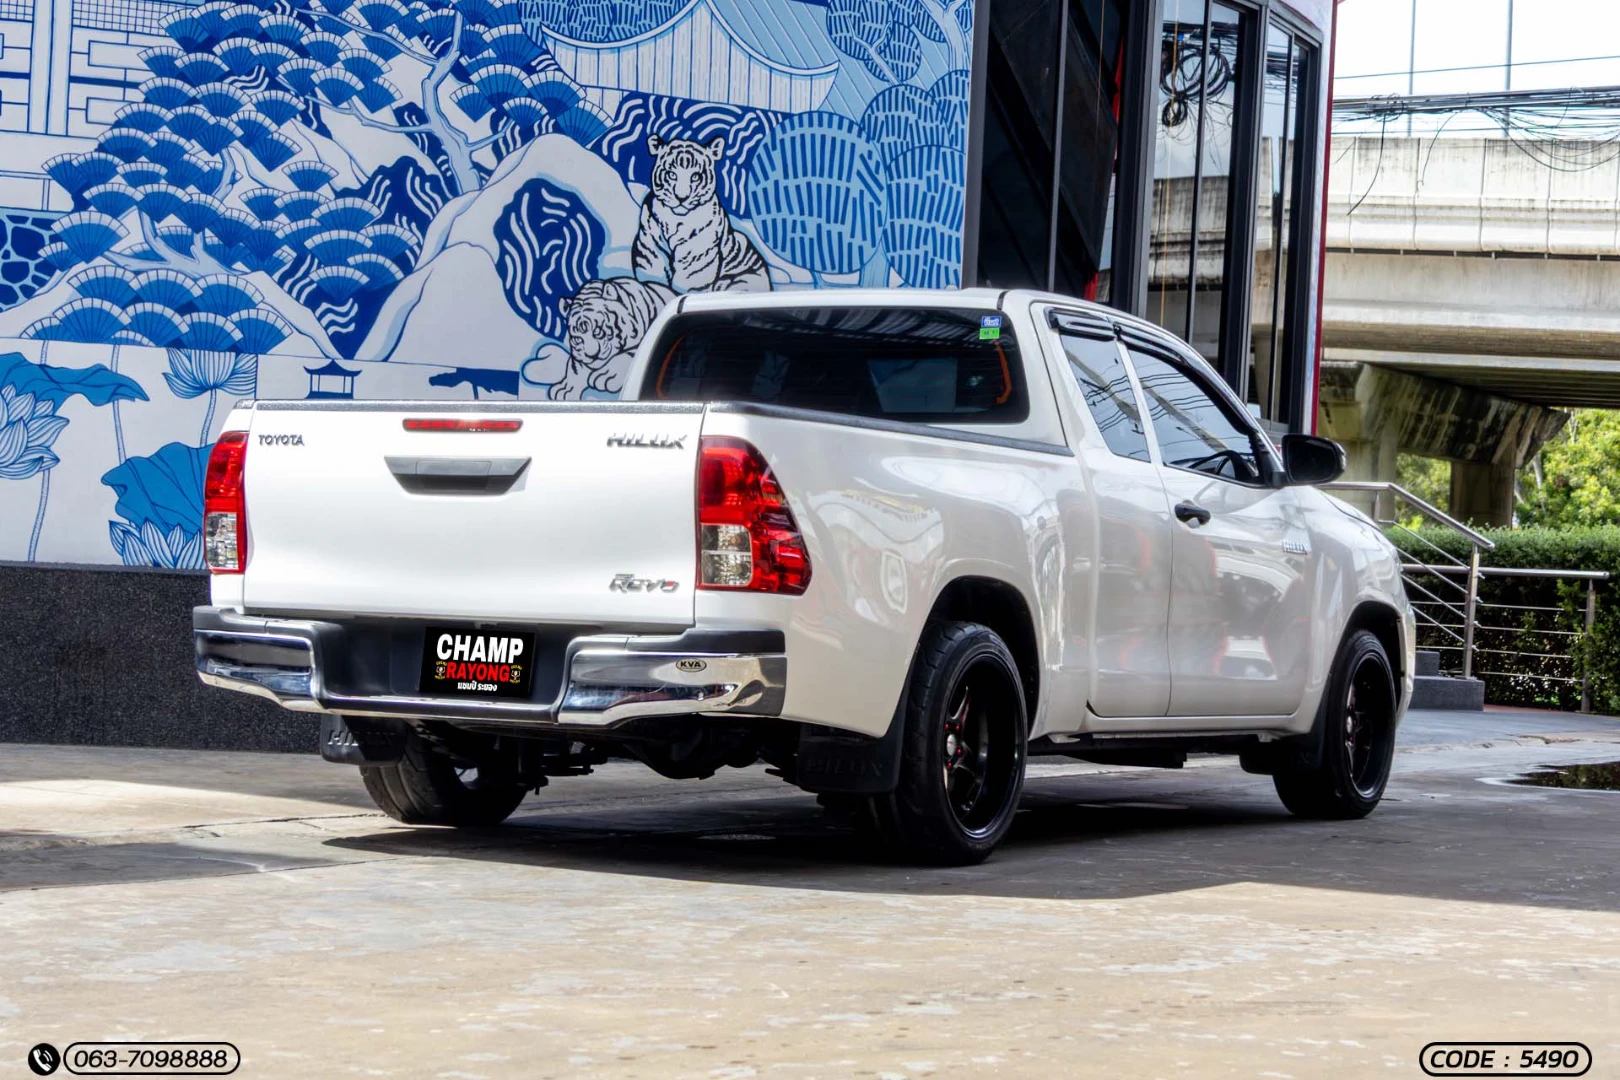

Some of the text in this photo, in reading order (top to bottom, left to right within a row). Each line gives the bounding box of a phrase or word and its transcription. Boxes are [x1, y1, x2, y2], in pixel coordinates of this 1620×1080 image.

[258, 434, 305, 447] TOYOTA
[606, 432, 688, 450] HILUX
[436, 633, 524, 664] CHAMP
[445, 661, 511, 682] RAYONG
[680, 660, 702, 668] KVA
